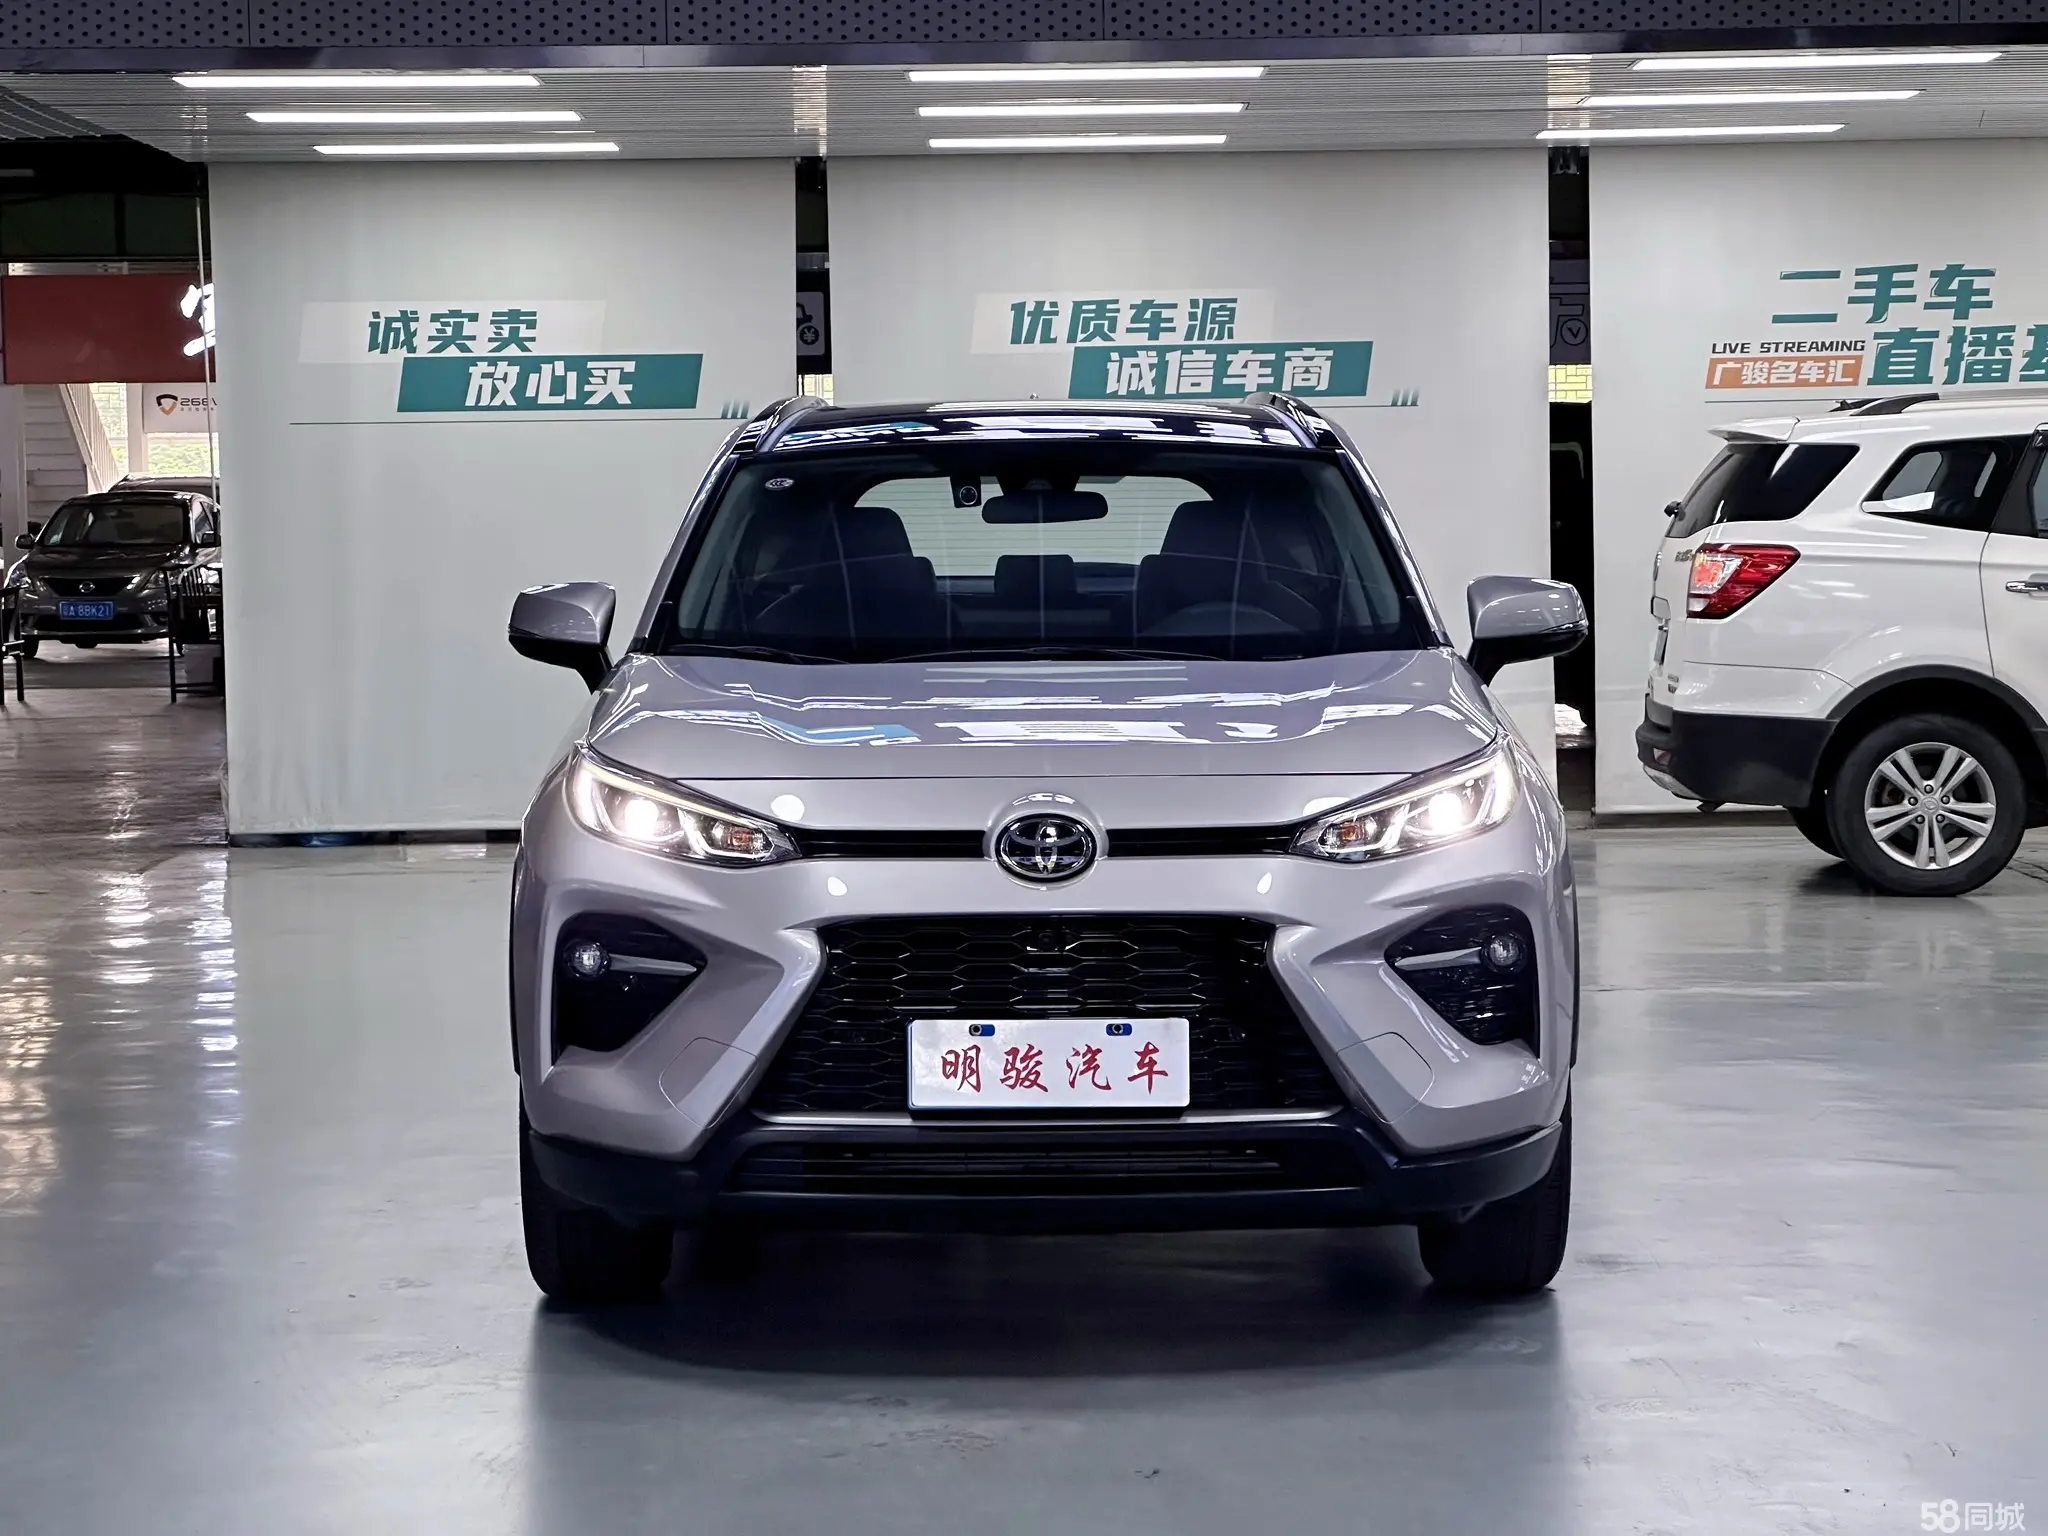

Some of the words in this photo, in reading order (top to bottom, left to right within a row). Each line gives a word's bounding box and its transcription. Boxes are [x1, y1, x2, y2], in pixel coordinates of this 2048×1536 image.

[1771, 264, 1997, 324] 二手车
[367, 308, 538, 354] 诚实卖
[1009, 297, 1239, 345] 优质车源
[1711, 342, 1751, 354] LIVE
[1759, 339, 1866, 354] STREAMING
[464, 360, 636, 406] 放心买
[1105, 347, 1334, 396] 诚信车商
[1712, 359, 1856, 386] 广骏名车汇
[940, 1041, 1169, 1095] 明骏汽车
